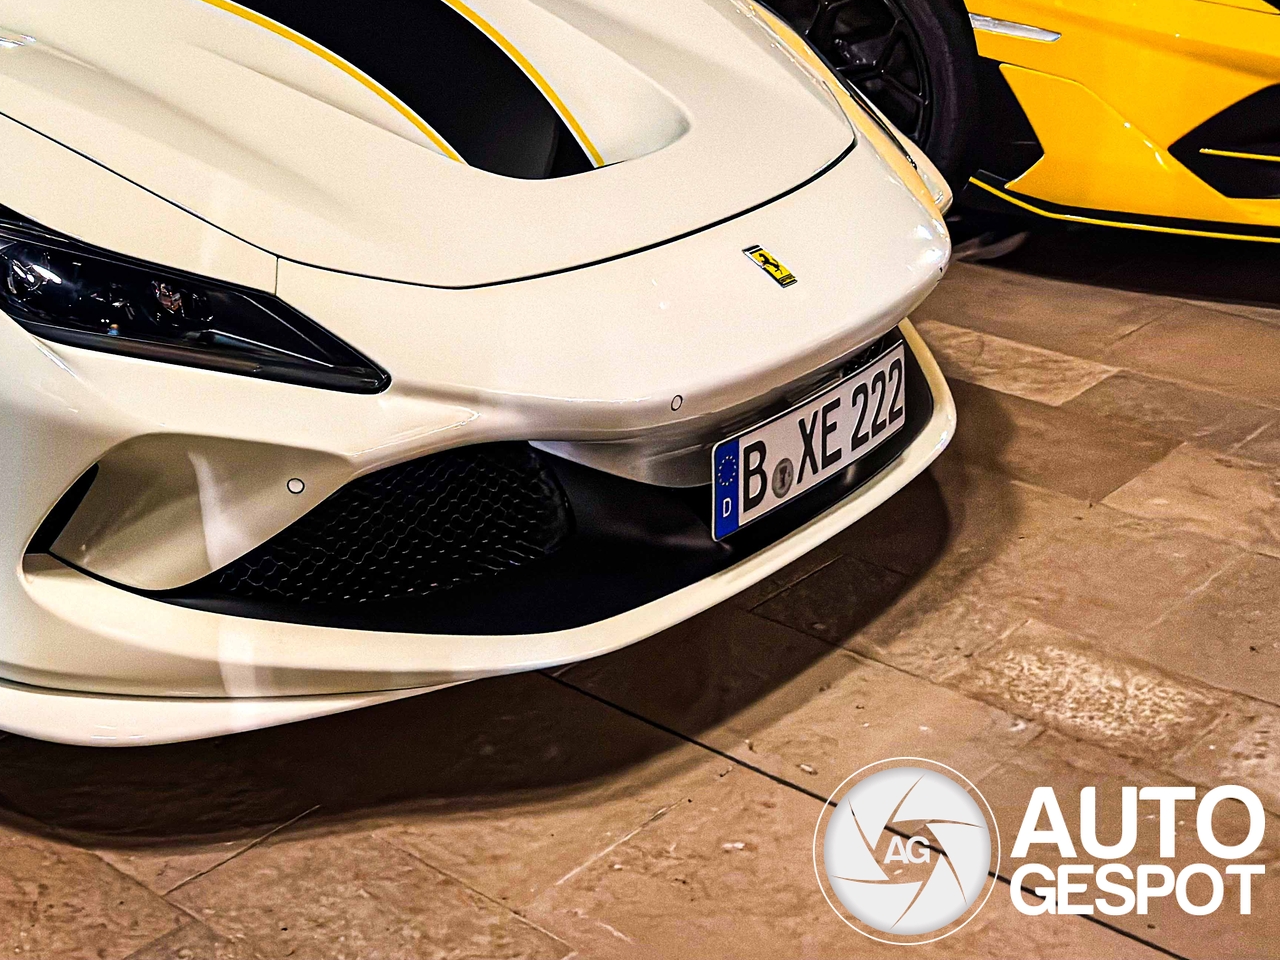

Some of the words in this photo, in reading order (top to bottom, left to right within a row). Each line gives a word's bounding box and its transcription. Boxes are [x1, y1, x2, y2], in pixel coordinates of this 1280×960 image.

[742, 440, 768, 515] B
[796, 397, 843, 485] XE
[851, 357, 904, 453] 222
[722, 497, 732, 518] D
